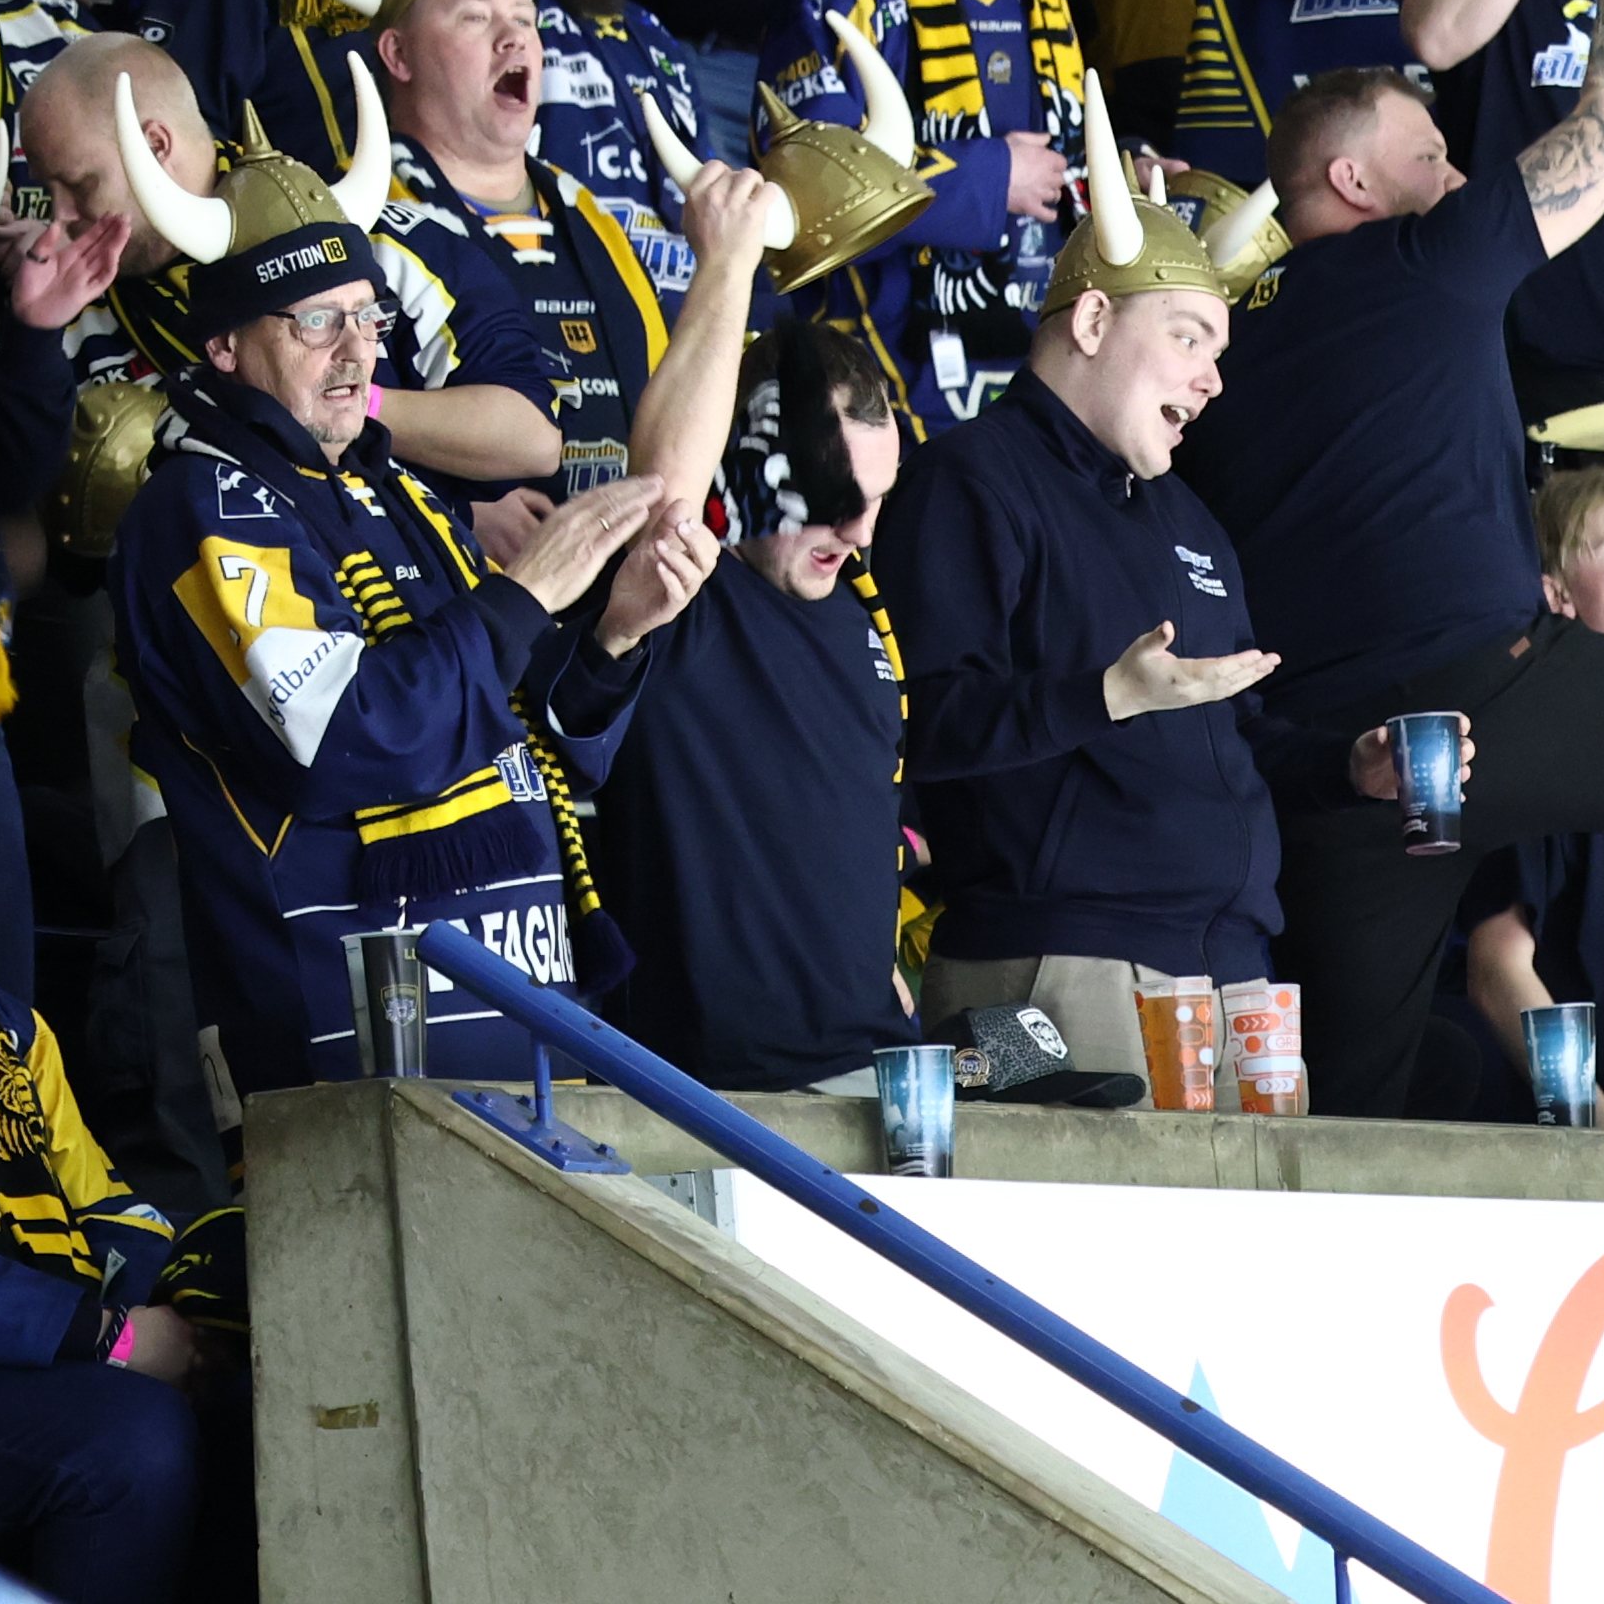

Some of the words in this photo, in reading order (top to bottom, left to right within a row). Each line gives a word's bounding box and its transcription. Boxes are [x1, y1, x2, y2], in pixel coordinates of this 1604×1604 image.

[256, 242, 327, 284] SEKTION
[324, 238, 345, 263] 18
[218, 555, 271, 629] 7
